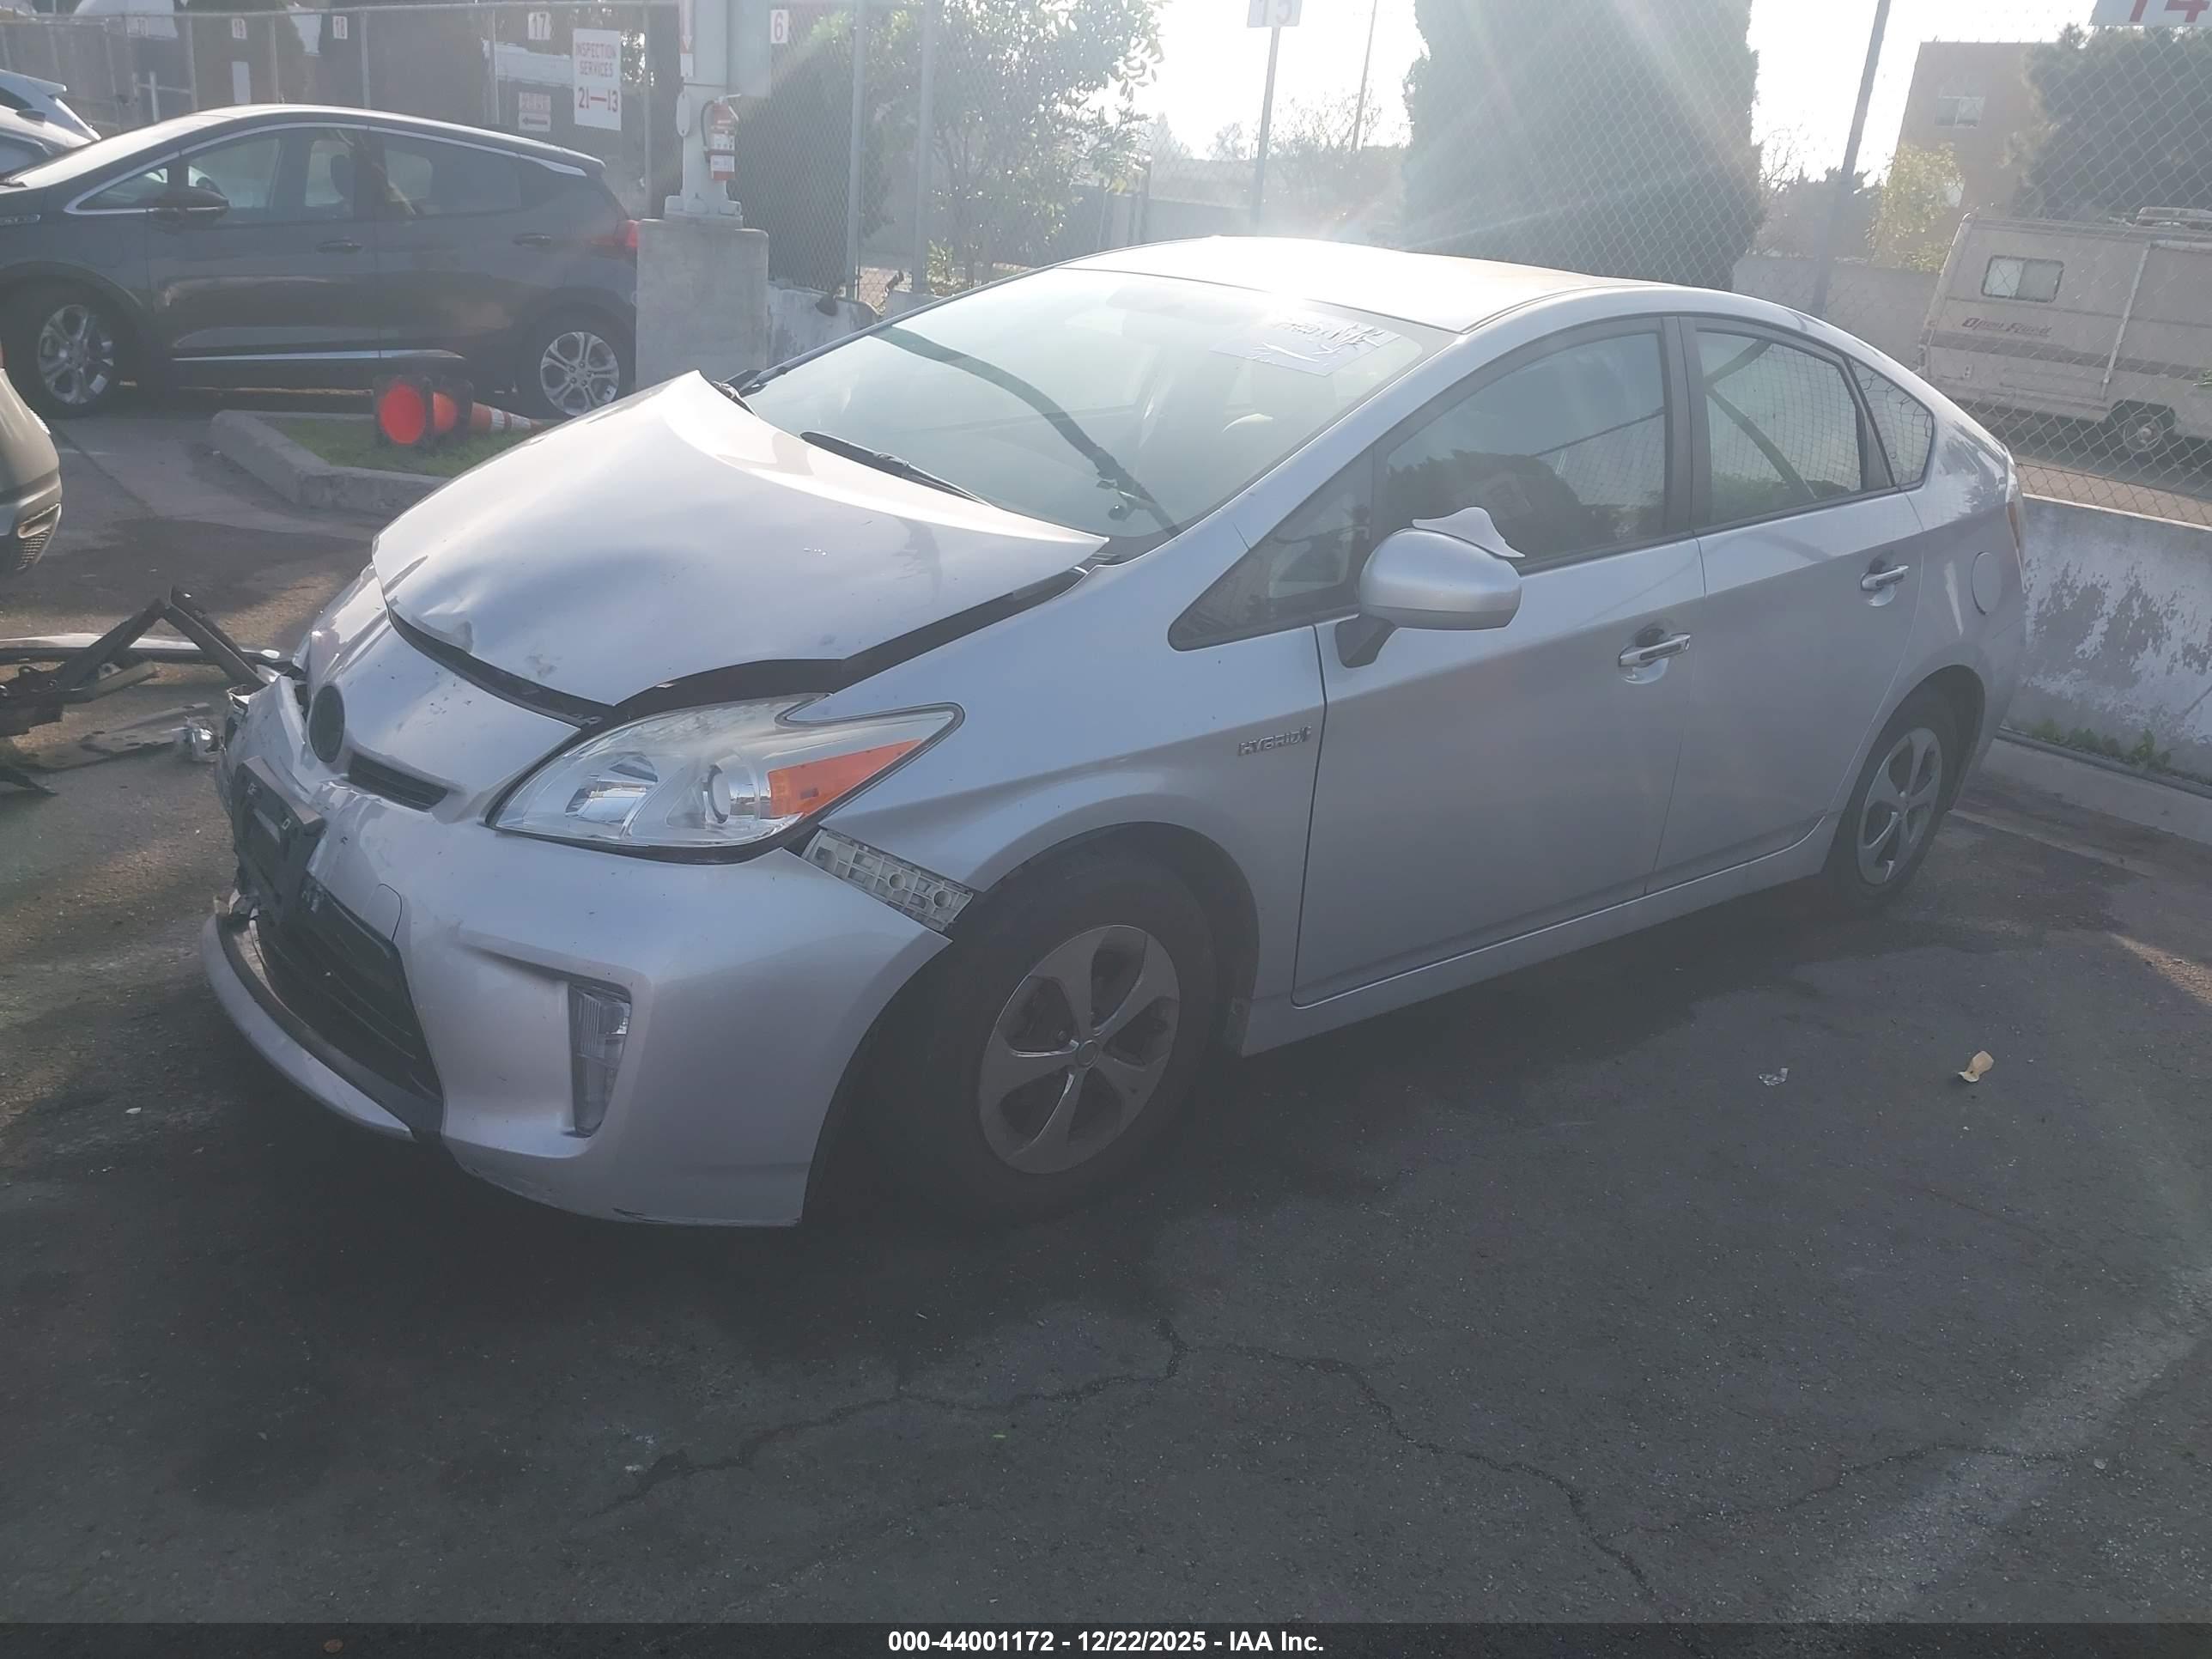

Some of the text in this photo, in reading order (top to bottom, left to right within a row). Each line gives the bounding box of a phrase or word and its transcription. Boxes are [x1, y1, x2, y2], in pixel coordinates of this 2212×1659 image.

[532, 13, 547, 39] 17
[575, 42, 617, 59] INSPECTION
[580, 61, 613, 77] SERVICES
[1237, 726, 1312, 757] HYBRID
